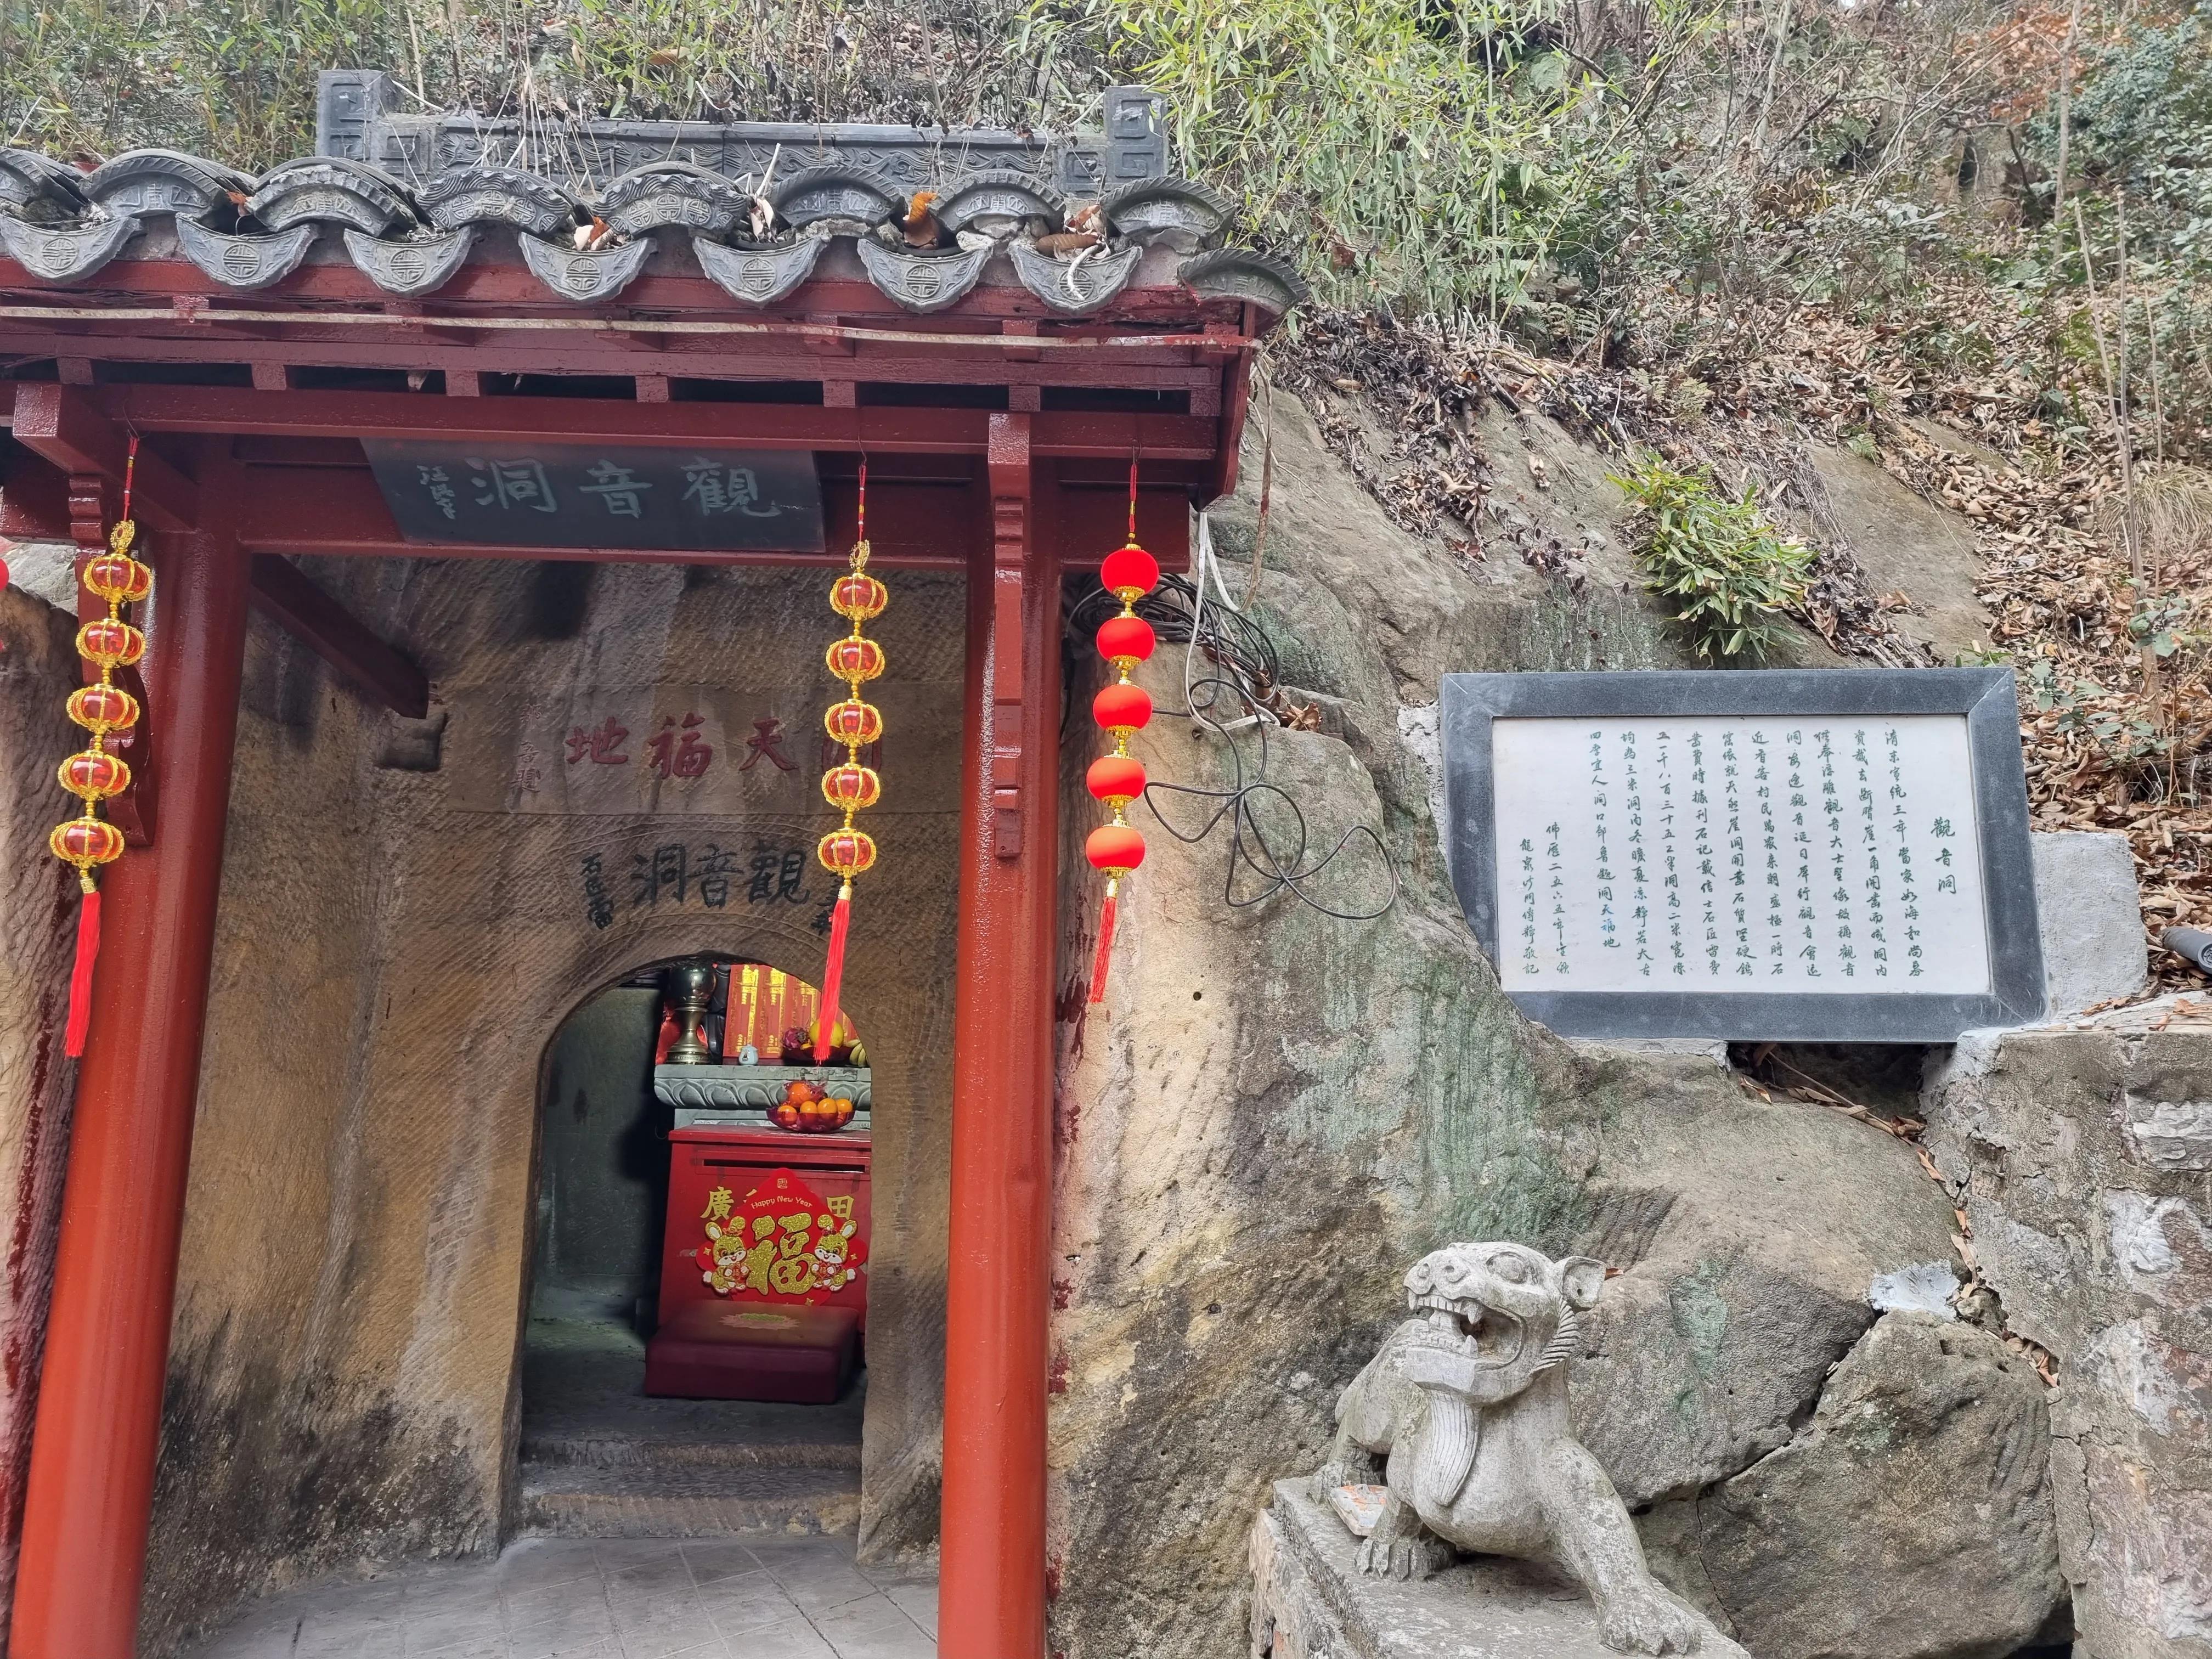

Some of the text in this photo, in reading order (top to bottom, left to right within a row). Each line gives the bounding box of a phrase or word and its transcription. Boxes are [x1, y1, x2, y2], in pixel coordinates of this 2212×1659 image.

[464, 454, 783, 519] 觀音洞
[631, 839, 810, 909] 觀音洞
[1930, 816, 1957, 894] 觀音洞
[751, 1195, 812, 1210] Happy New Year
[746, 1212, 820, 1296] 福
